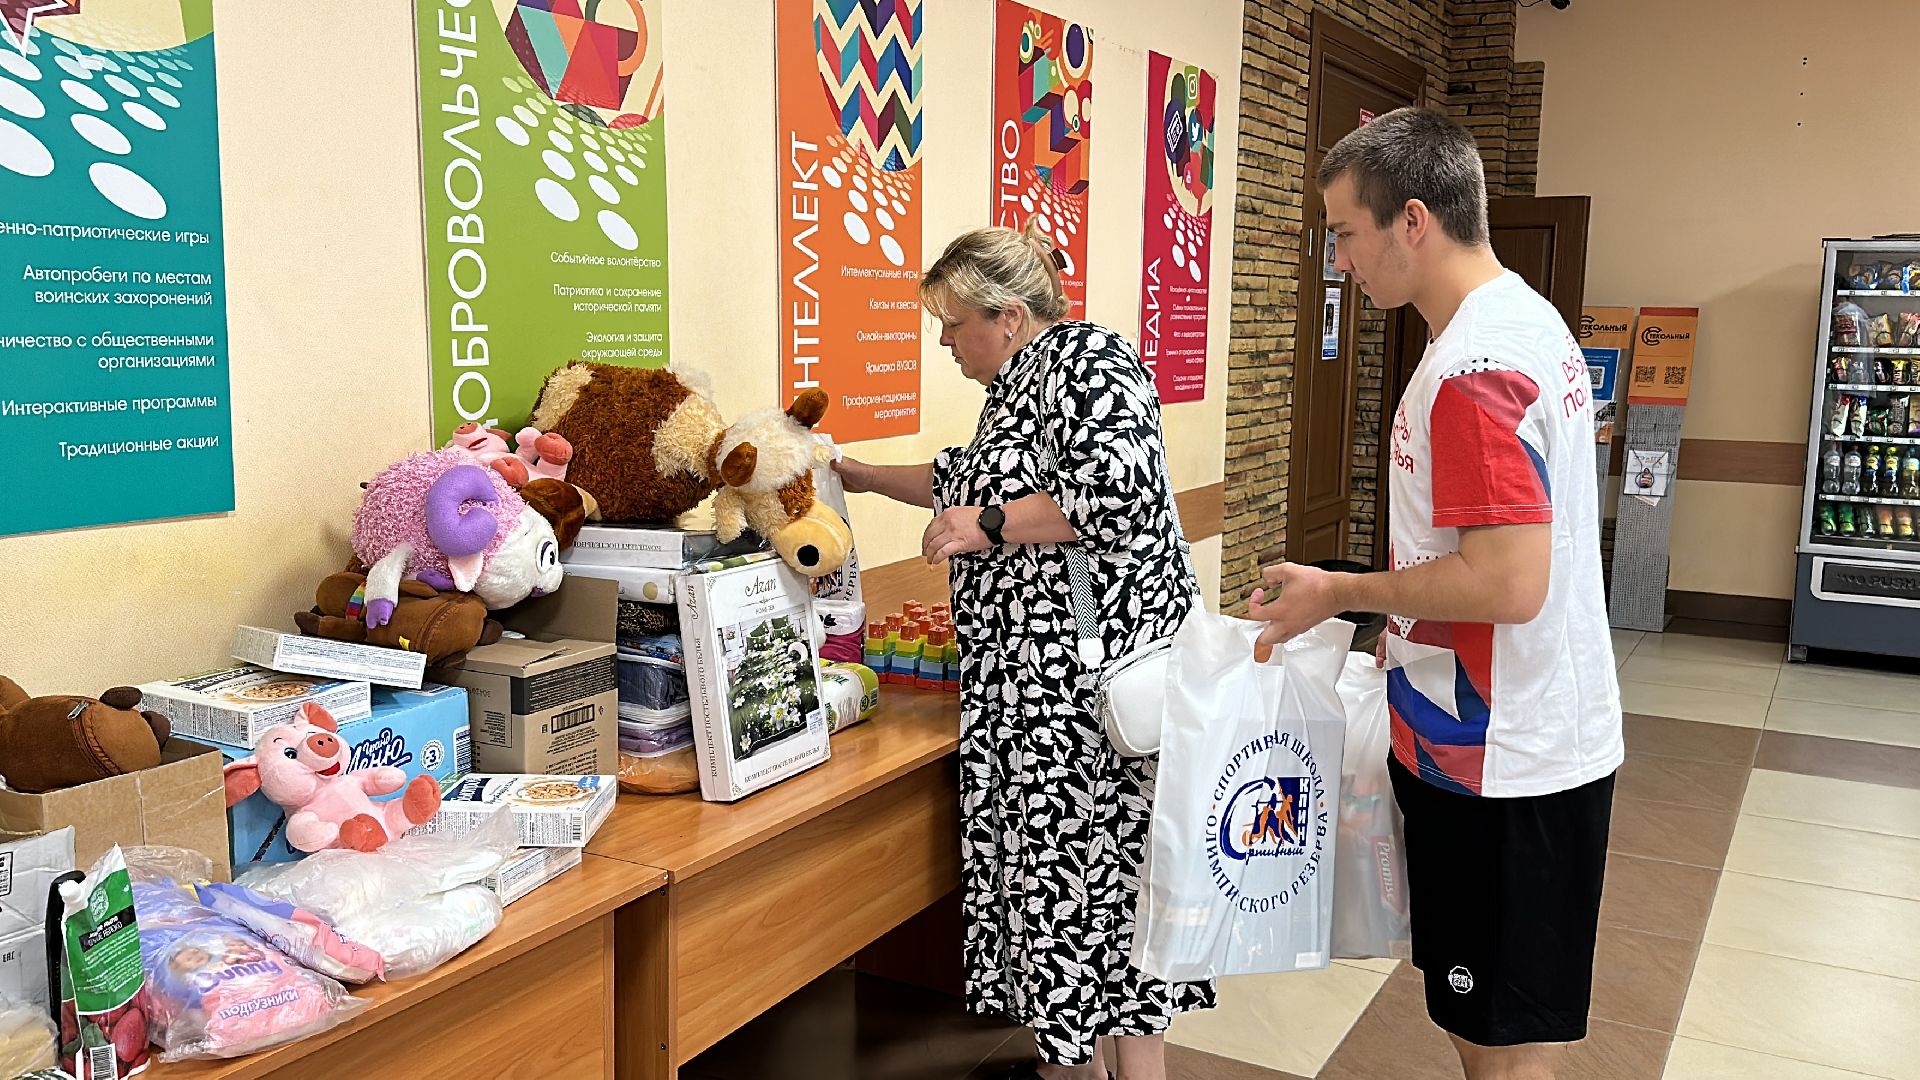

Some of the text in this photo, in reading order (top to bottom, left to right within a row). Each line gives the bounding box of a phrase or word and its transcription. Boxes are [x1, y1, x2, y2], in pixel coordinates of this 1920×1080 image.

[438, 0, 495, 430] ОБРОВОЛЬЧЕ
[175, 231, 210, 247] игры
[551, 251, 661, 269] Событийное волонтёрство
[791, 131, 820, 402] НТЕЛЛЕКТ
[23, 265, 212, 285] Автопробеги по местам
[841, 265, 918, 282] Интеллектуальные игры
[35, 290, 213, 308] воинских захоронений
[553, 283, 662, 298] Патриотика и сохранение
[573, 302, 662, 314] исторической памяти
[869, 298, 890, 309] Квизы
[896, 301, 918, 309] квесты
[77, 335, 88, 347] с
[91, 331, 215, 349] общественными
[586, 332, 663, 343] Экология и защита
[581, 347, 663, 361] окружающей среды
[98, 355, 216, 372] организациями
[865, 361, 895, 375] Ярмарка
[1, 395, 218, 418] Интерактивные программы
[58, 435, 220, 461] Традиционные акции
[744, 576, 777, 597] Azan
[1214, 729, 1326, 802] СПОРТИВЯ ШКОЛА
[1205, 811, 1329, 914] ОЛИМПИСКОГО РЕЗЕРВА
